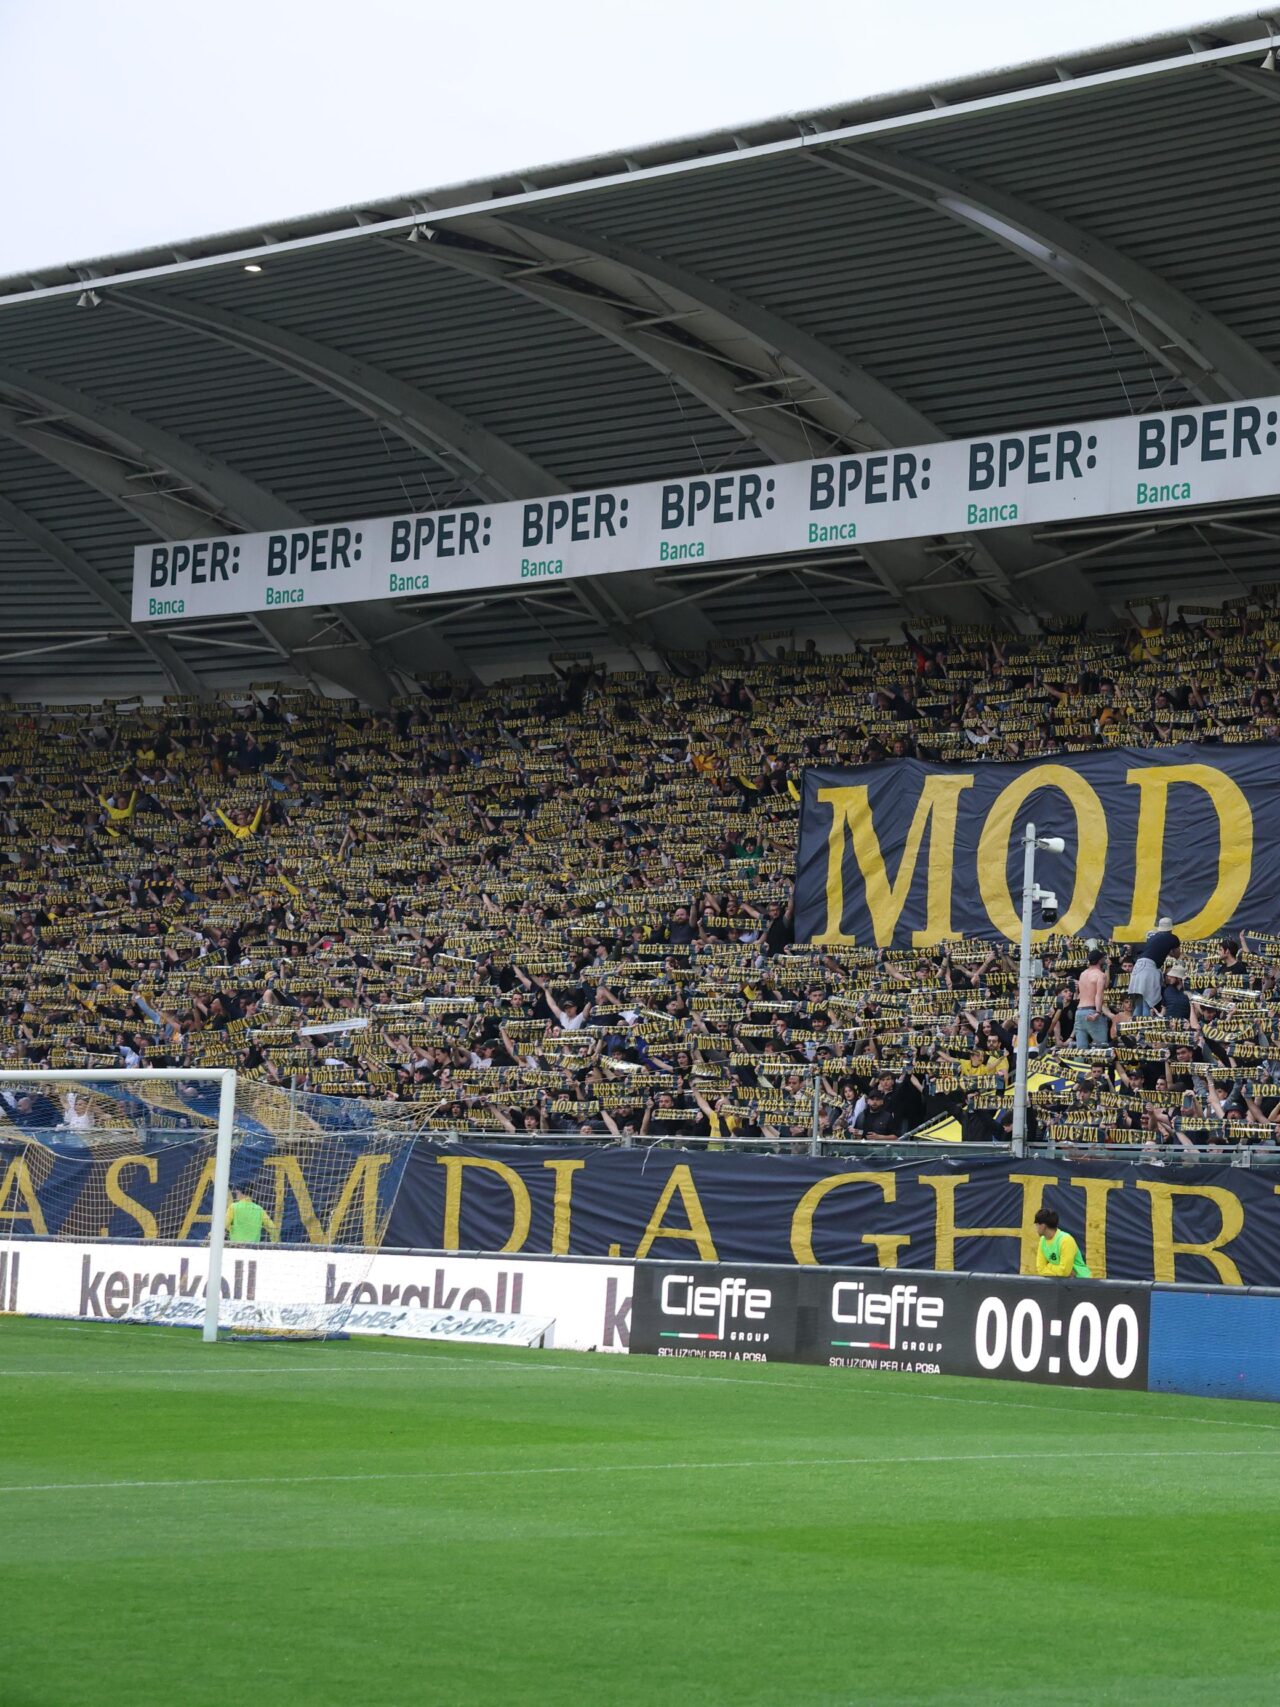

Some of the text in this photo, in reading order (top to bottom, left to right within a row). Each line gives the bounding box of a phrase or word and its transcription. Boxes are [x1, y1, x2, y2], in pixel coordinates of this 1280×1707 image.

[1139, 406, 1277, 469] BPER:
[969, 431, 1096, 491] BPER:
[810, 453, 930, 510] BPER:
[662, 474, 774, 529] BPER:
[1136, 482, 1191, 506] Banca
[523, 494, 628, 547] BPER:
[967, 504, 1017, 524] Banca
[391, 512, 491, 562] BPER:
[808, 523, 856, 543] Banca
[268, 528, 362, 576] BPER:
[660, 541, 704, 560] Banca
[150, 541, 240, 587] BPER:
[522, 560, 562, 577] Banca
[389, 574, 429, 592] Banca
[149, 598, 184, 615] Banca
[266, 587, 304, 604] Banca
[1252, 1084, 1277, 1097] MOD
[661, 1275, 772, 1340] Cieffe
[832, 1282, 944, 1349] Cieffe
[730, 1332, 769, 1342] GROUP
[902, 1341, 942, 1352] GROUP
[976, 1297, 1138, 1378] 00:00
[743, 1352, 767, 1362] POSA
[829, 1357, 940, 1374] SOLUZIONI PER LA POSA
